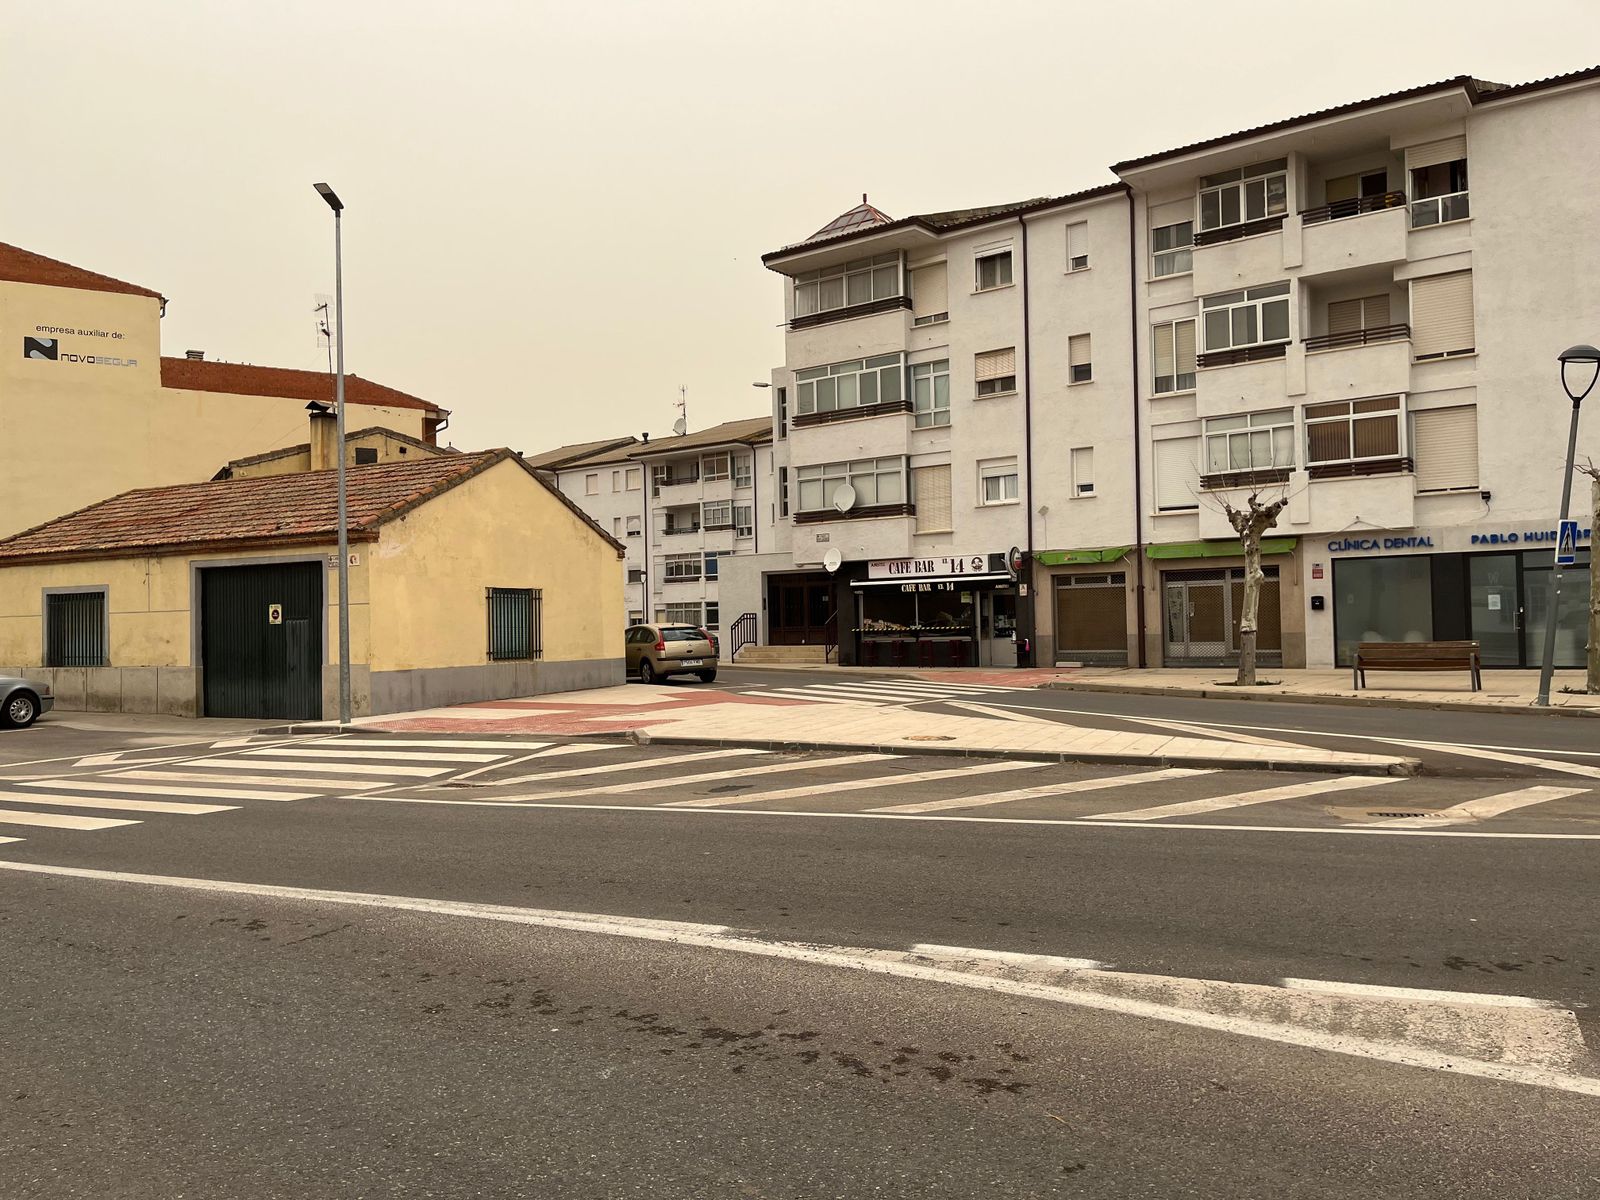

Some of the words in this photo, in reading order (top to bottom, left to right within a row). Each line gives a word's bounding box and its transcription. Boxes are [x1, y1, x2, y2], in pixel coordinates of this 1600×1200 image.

[36, 325, 75, 335] empresa
[77, 328, 109, 338] auxiliar
[111, 331, 126, 340] de:
[1328, 538, 1380, 552] CLÍNICA
[1383, 536, 1434, 549] DENTAL
[1471, 532, 1519, 545] PABLO
[888, 561, 911, 574] CAFE
[915, 560, 935, 573] BAR
[950, 558, 964, 573] 14
[901, 584, 916, 592] CAFE
[918, 583, 931, 592] BAR
[946, 582, 954, 591] 14
